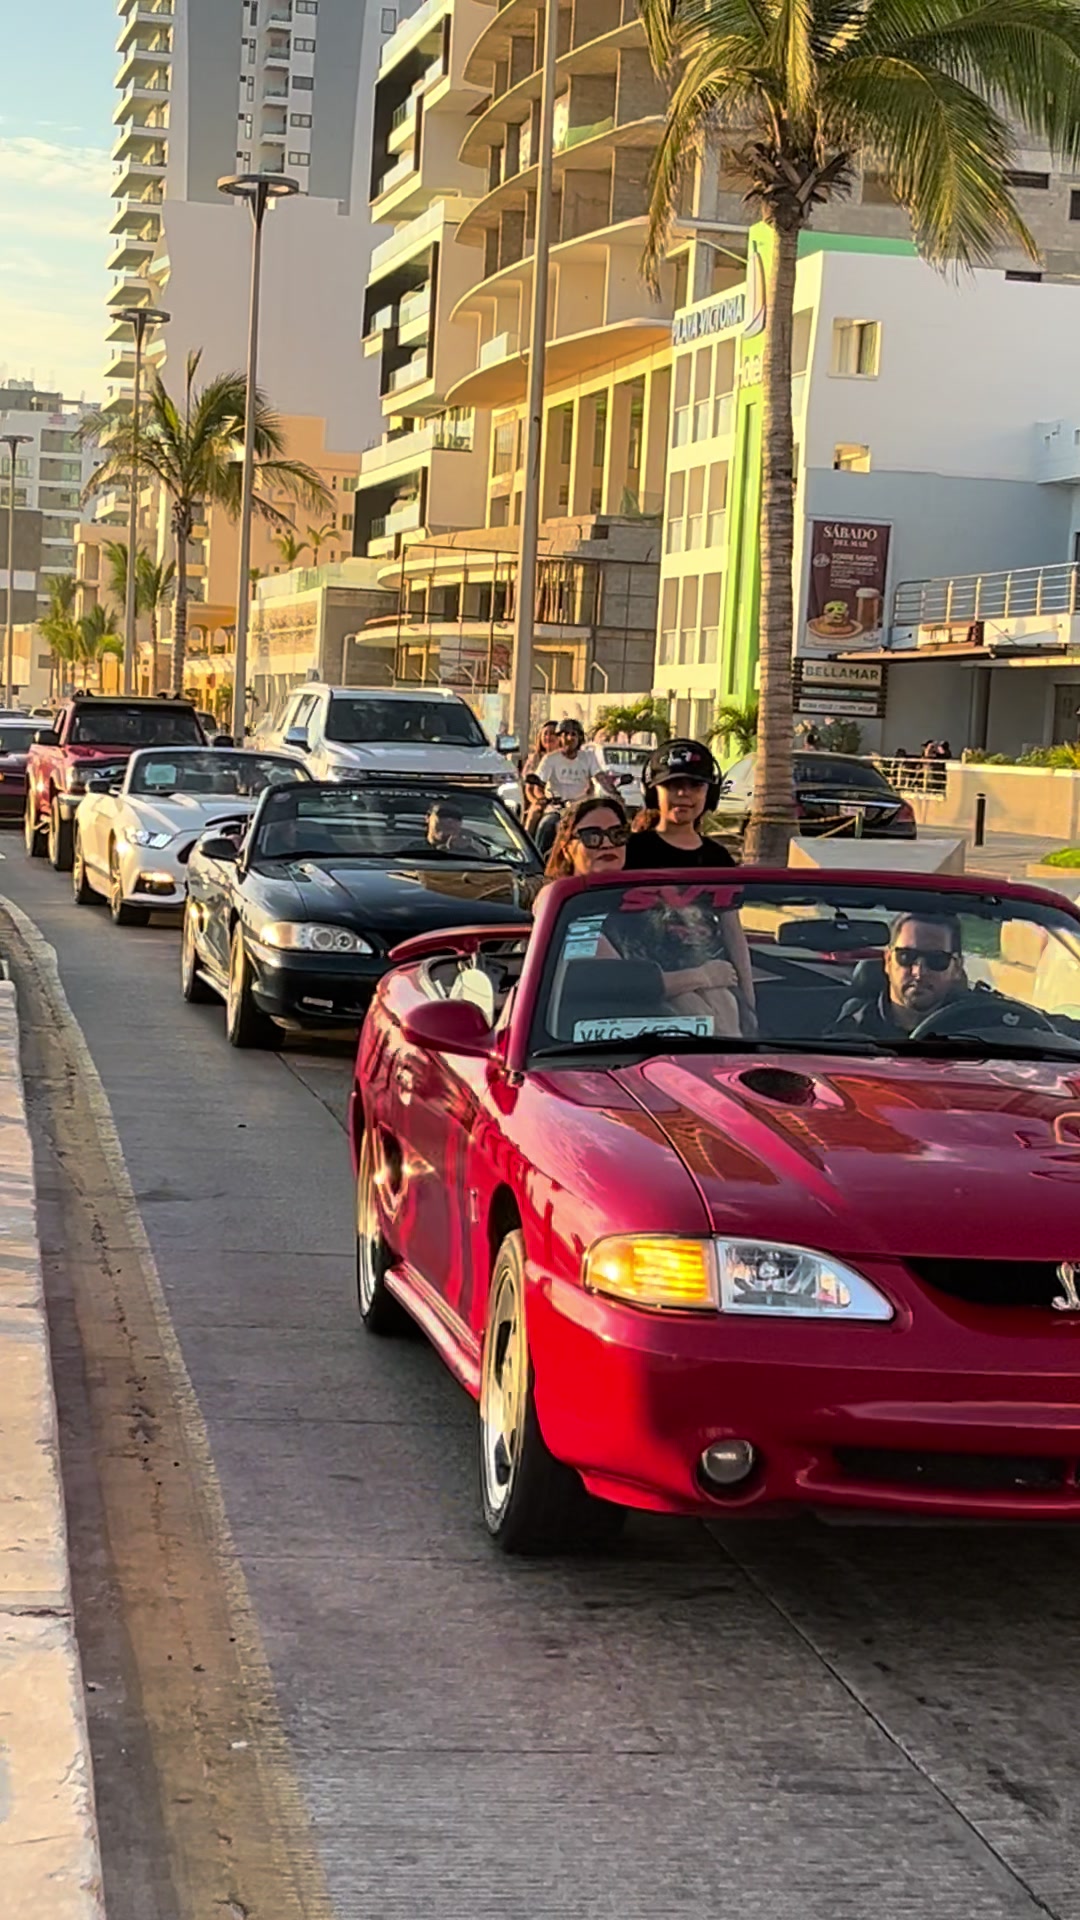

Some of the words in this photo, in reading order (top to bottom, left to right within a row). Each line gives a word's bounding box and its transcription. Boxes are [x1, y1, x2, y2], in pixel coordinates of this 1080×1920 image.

[702, 294, 745, 335] VICTORIA
[823, 524, 878, 541] SÁBADO
[805, 666, 879, 680] BELLAMAR
[620, 884, 744, 913] SVT
